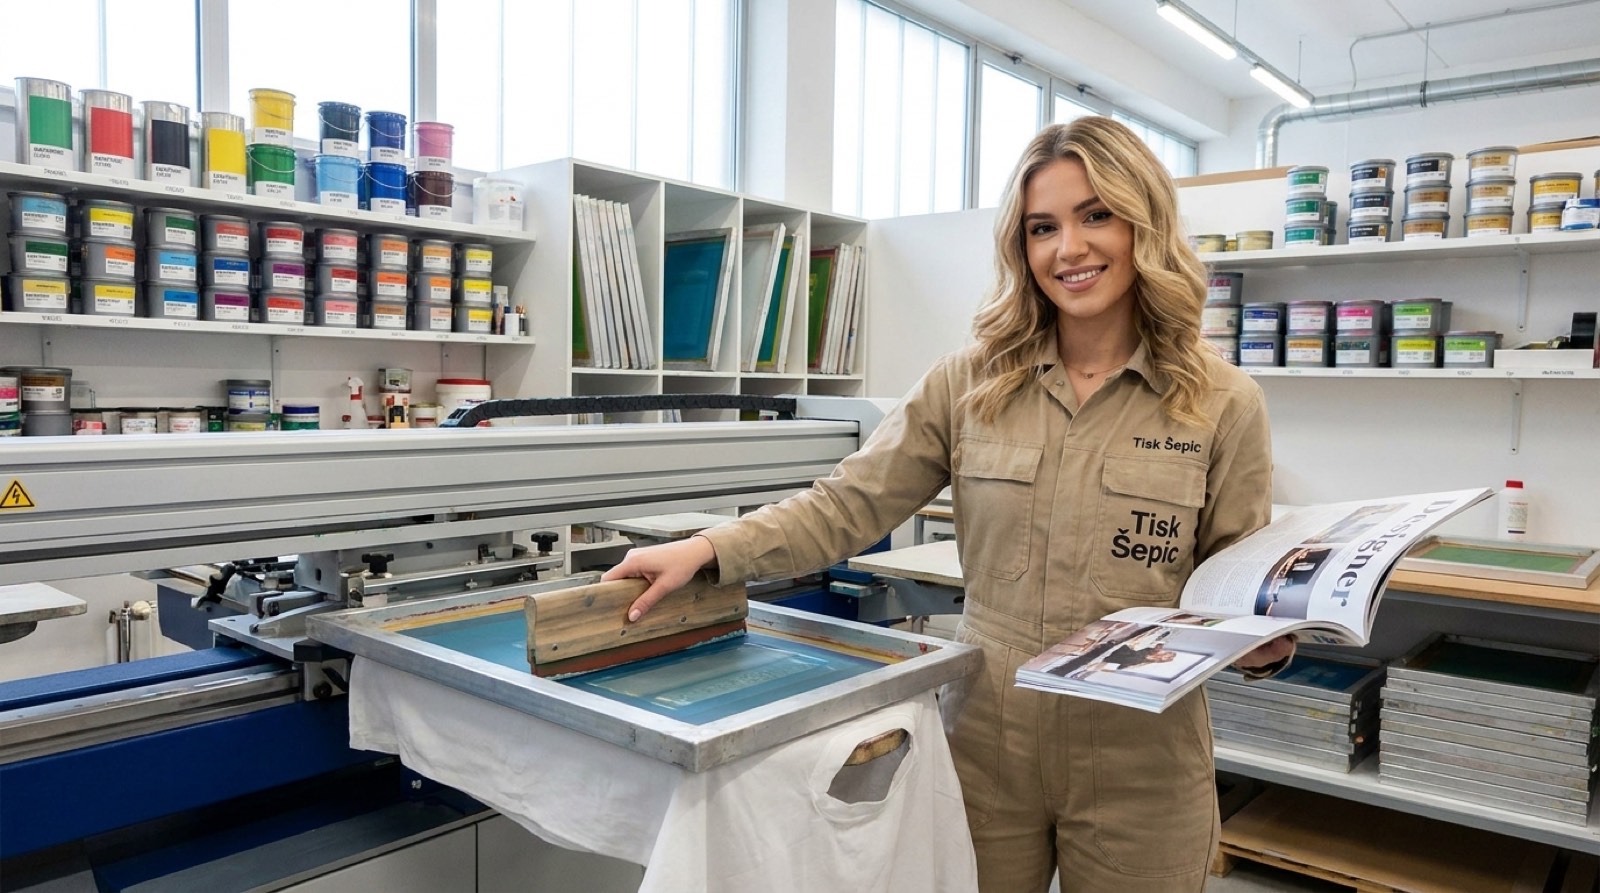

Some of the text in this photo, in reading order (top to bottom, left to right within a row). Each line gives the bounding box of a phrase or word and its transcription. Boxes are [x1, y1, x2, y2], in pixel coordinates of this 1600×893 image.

[1133, 437, 1161, 450] Tisk
[1131, 510, 1181, 538] Tisk
[1111, 528, 1179, 568] Šepic
[1330, 498, 1458, 608] Designer
